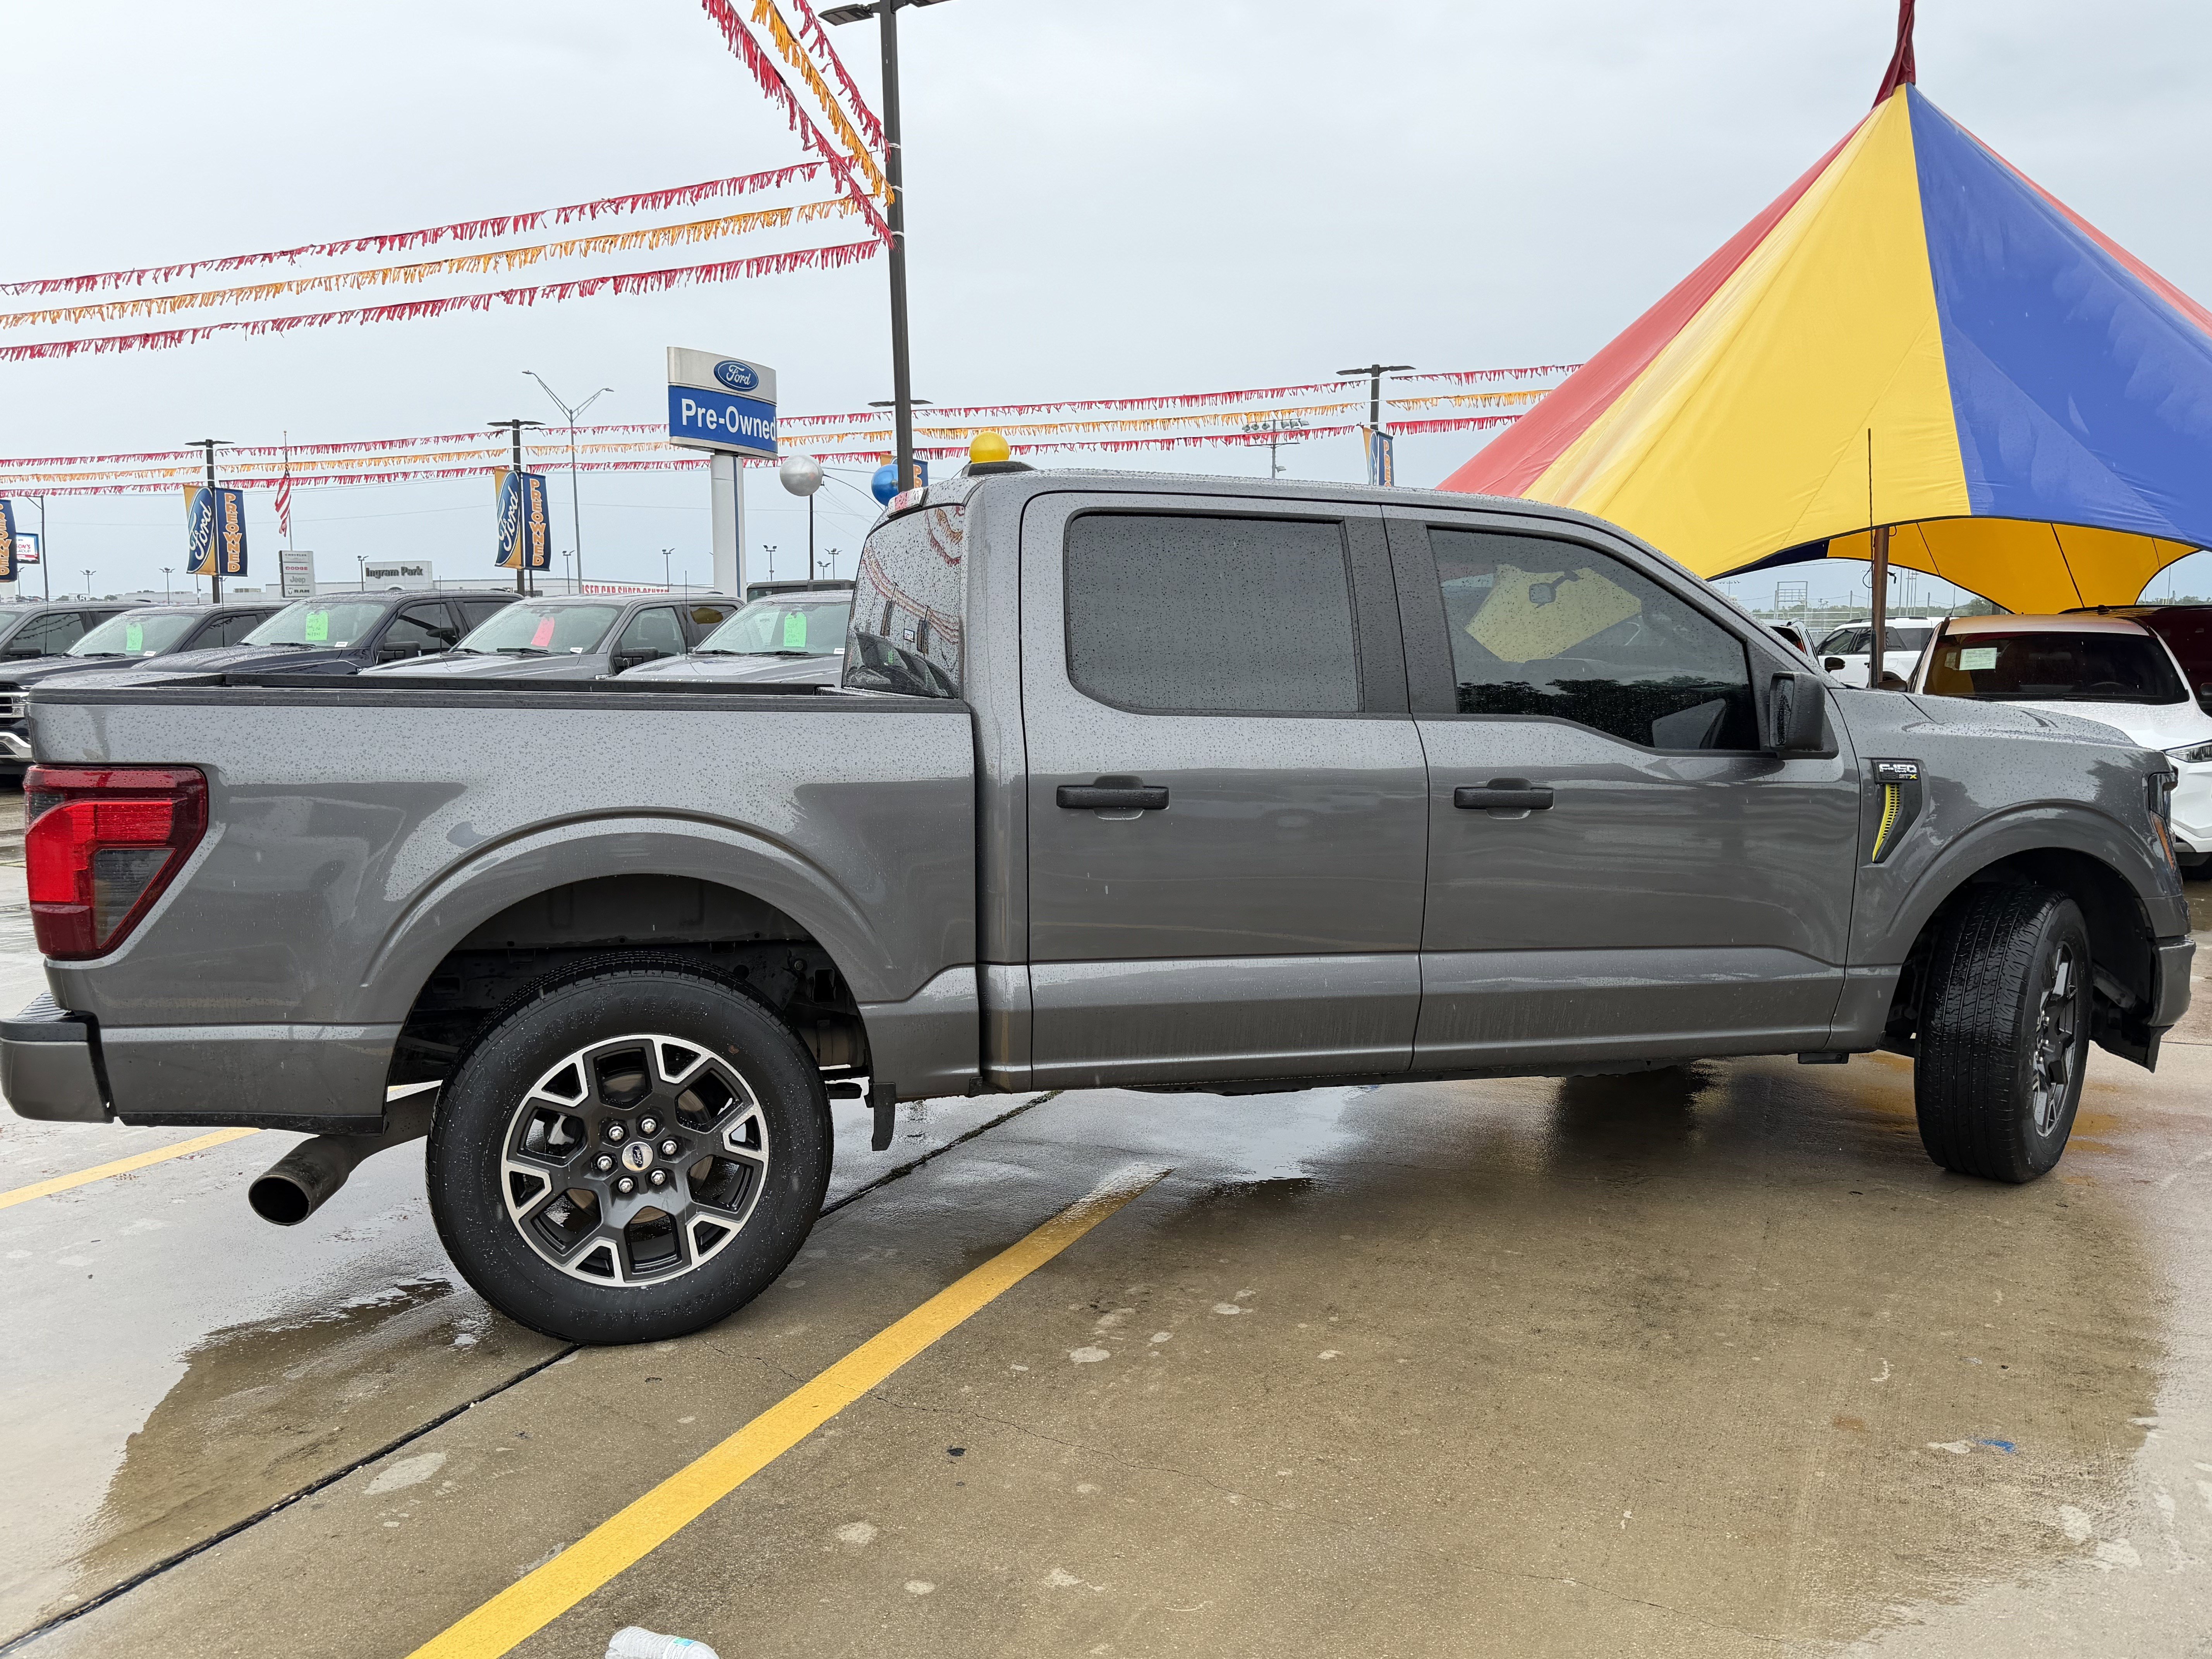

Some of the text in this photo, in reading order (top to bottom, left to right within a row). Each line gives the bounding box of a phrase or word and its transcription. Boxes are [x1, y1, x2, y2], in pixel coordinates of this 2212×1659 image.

[726, 364, 751, 385] Ford
[681, 398, 776, 441] Pre-Owned
[189, 500, 212, 560] Ford
[223, 493, 242, 572] PREOWNED
[498, 485, 519, 551] Ford
[529, 478, 546, 566] PREOWNED
[366, 566, 423, 579] Ingram Park
[1879, 764, 1917, 773] F-150
[634, 1149, 642, 1164] Ford
